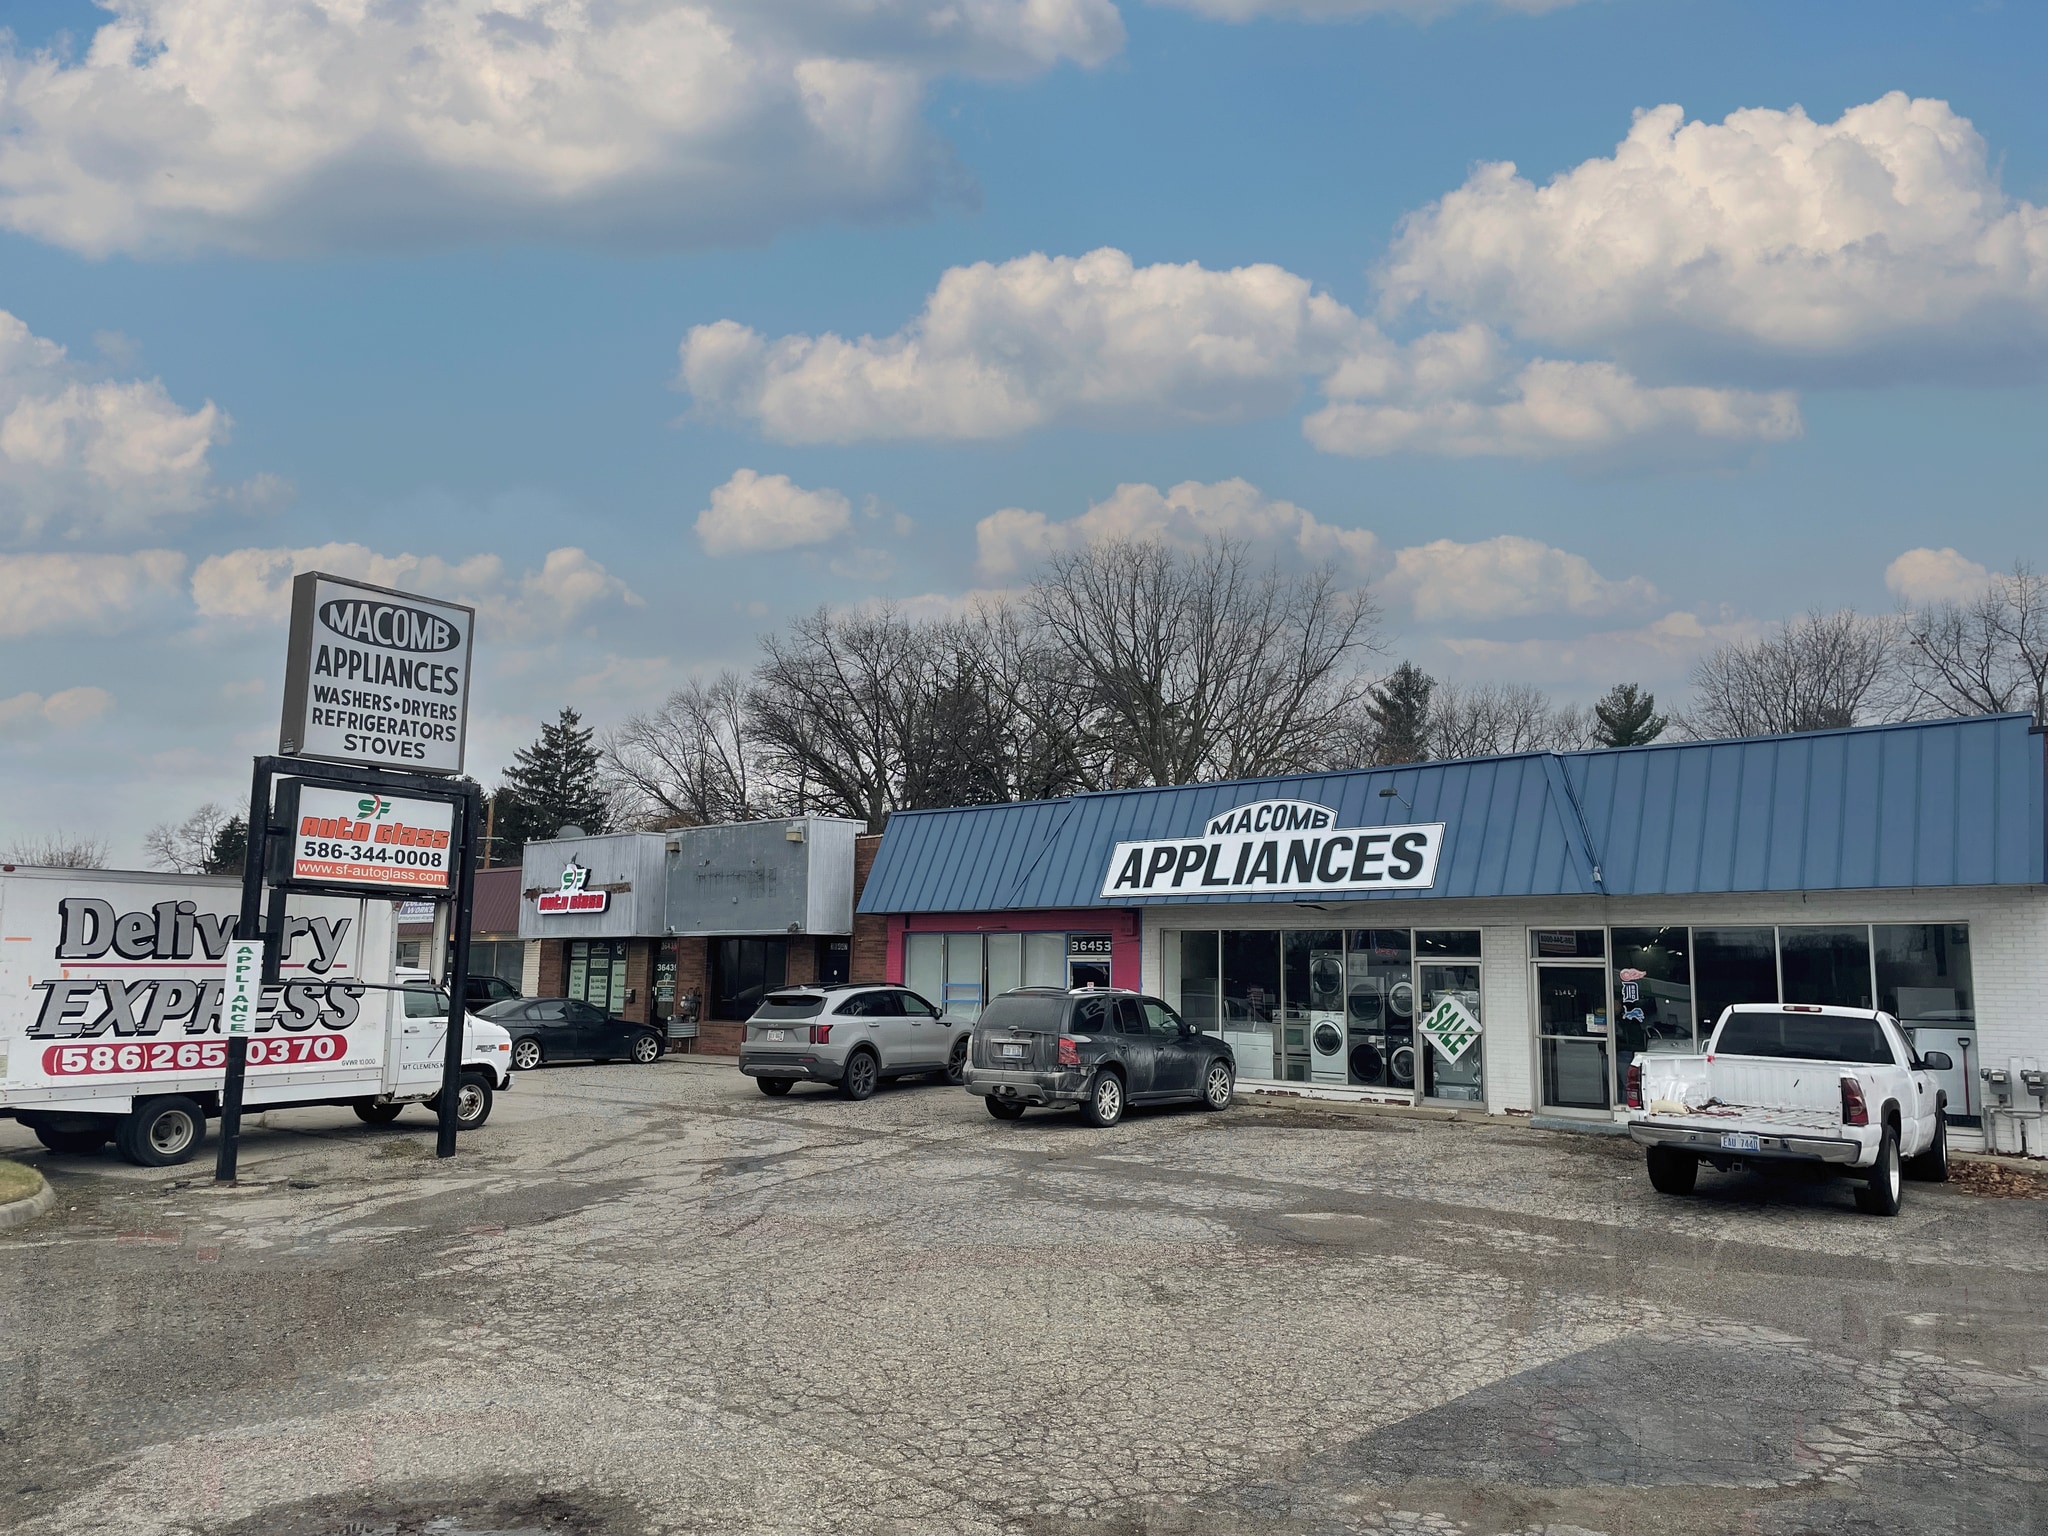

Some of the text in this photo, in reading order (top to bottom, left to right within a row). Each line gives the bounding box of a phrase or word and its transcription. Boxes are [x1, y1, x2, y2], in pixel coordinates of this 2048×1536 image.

[329, 602, 450, 650] MACOMB
[315, 644, 459, 696] APPLIANCES
[312, 707, 457, 742] REFRIGERATORS
[343, 733, 426, 759] STOVES
[1210, 804, 1329, 835] MACOMB
[298, 861, 446, 882] www.sf-autoglass.com
[303, 841, 442, 868] 586-344-0008
[1113, 832, 1428, 890] APPLIANCES
[55, 898, 352, 974] Delivry
[1071, 941, 1111, 951] 36453
[230, 946, 254, 1032] APPLIANCE
[1426, 1002, 1475, 1056] SALE
